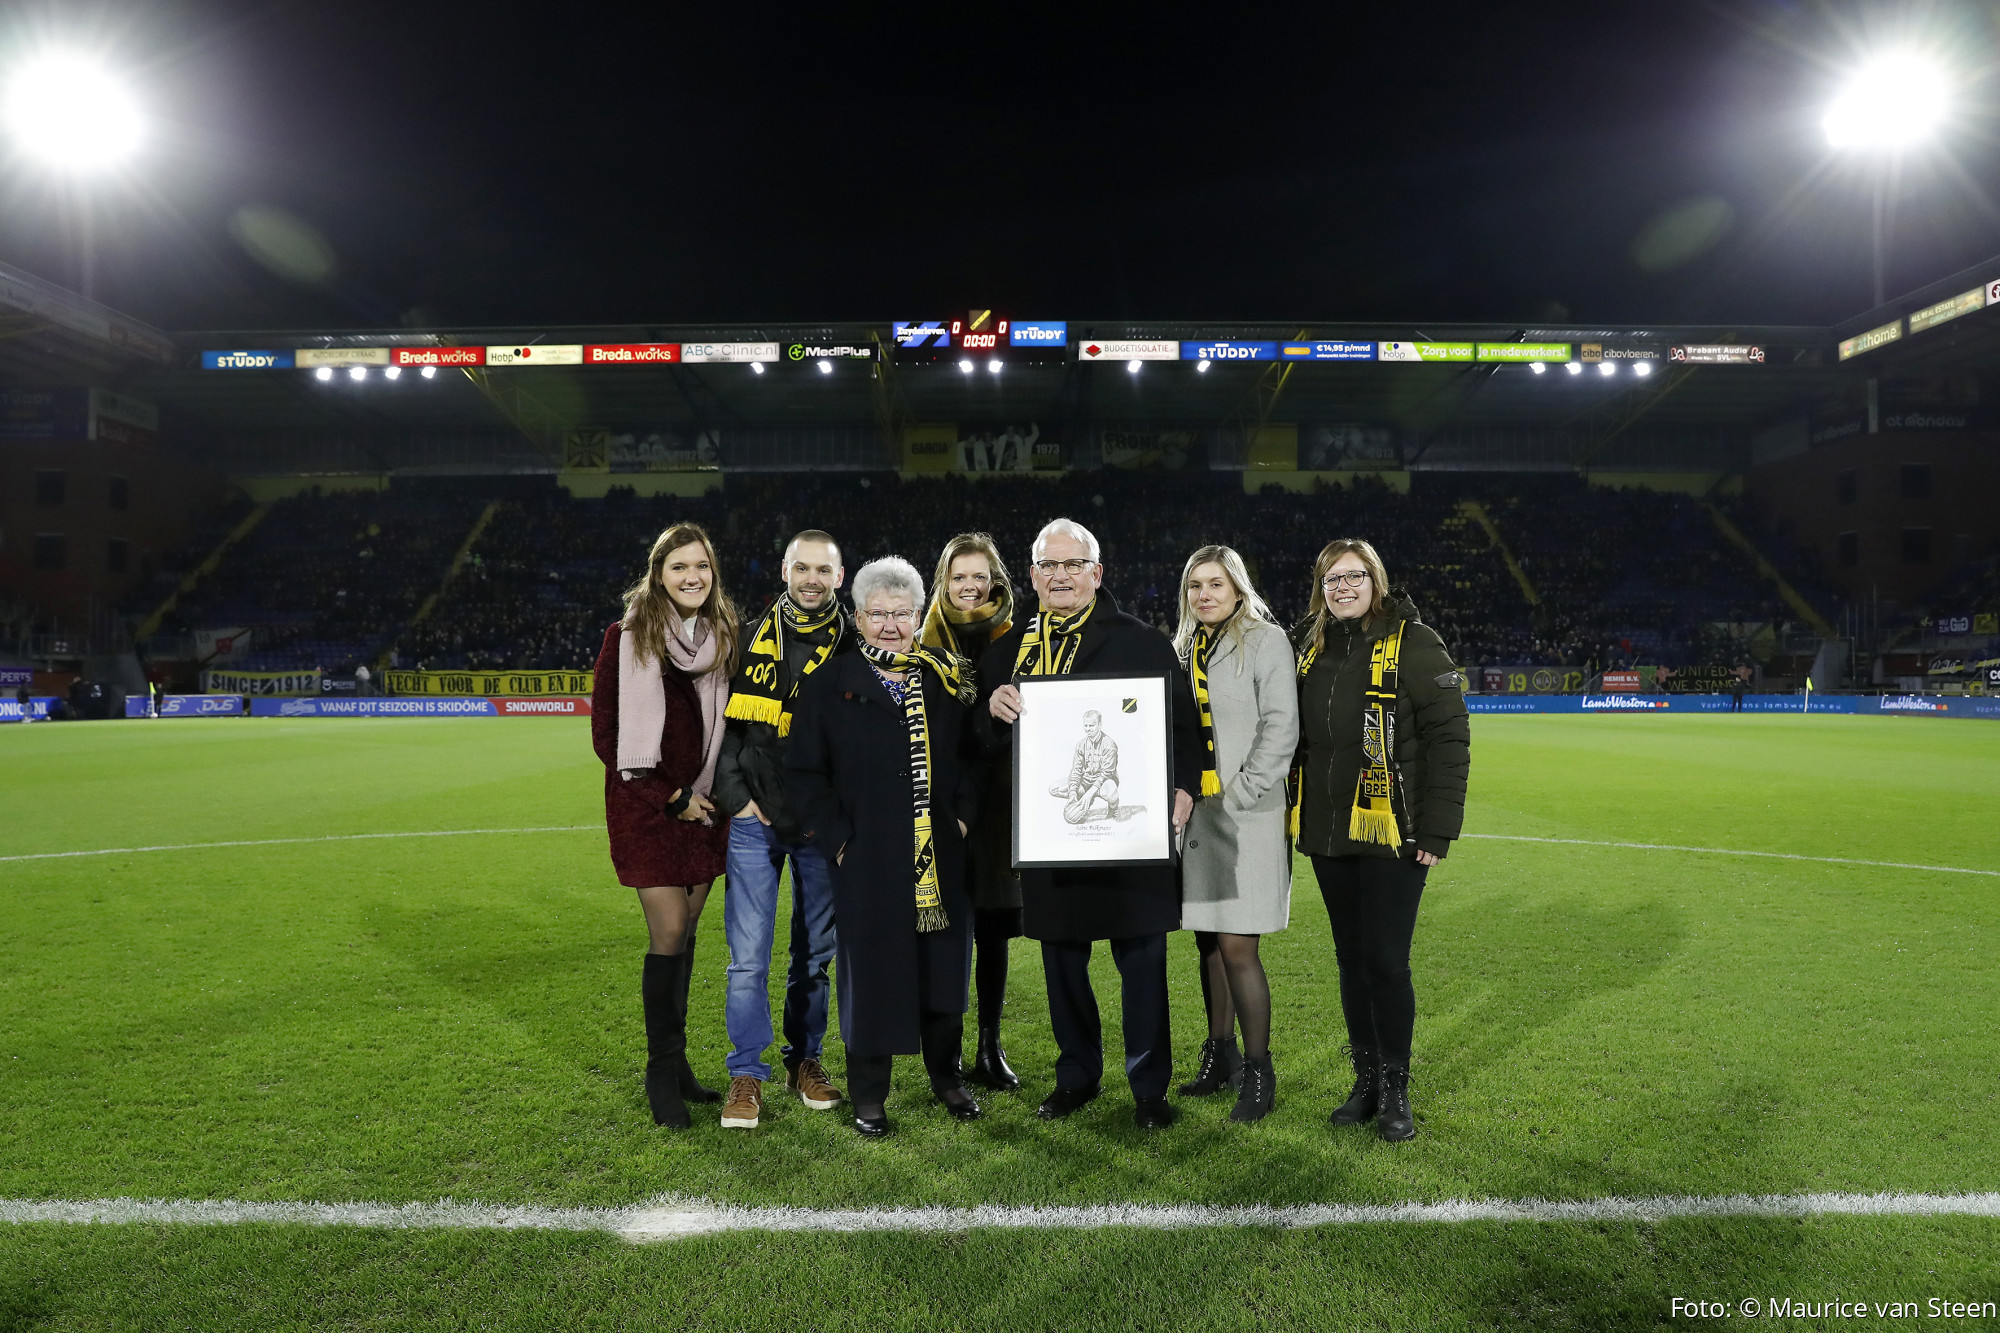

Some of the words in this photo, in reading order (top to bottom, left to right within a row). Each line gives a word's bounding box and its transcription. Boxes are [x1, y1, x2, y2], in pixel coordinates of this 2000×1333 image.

[953, 322, 961, 334] 0
[999, 321, 1007, 334] 0
[963, 334, 996, 347] 00:00
[593, 348, 671, 361] Breda.works
[805, 346, 871, 357] MediPlus
[1421, 346, 1447, 358] Zorg
[1448, 347, 1473, 356] voor
[1477, 346, 1491, 359] je
[1494, 346, 1566, 357] medewerkers!
[1582, 349, 1601, 358] cibo
[1687, 346, 1721, 354] Brabant
[1723, 346, 1748, 354] Audio
[400, 351, 477, 363] Breda.works
[1035, 443, 1060, 455] 1973
[1677, 665, 1728, 677] UNITED
[211, 673, 260, 694] SINCE
[439, 676, 474, 693] VOOR
[484, 677, 501, 694] DE
[509, 676, 542, 693] CLUB
[548, 674, 565, 692] EN
[570, 675, 587, 692] DE
[1508, 673, 1527, 692] 19
[1668, 679, 1691, 691] WE
[321, 702, 357, 712] VANAF
[359, 702, 376, 712] DIT
[378, 702, 424, 712] SEIZOEN
[426, 702, 435, 712] IS
[505, 701, 575, 712] SNOWWORLD
[1582, 695, 1648, 708] LambWeston
